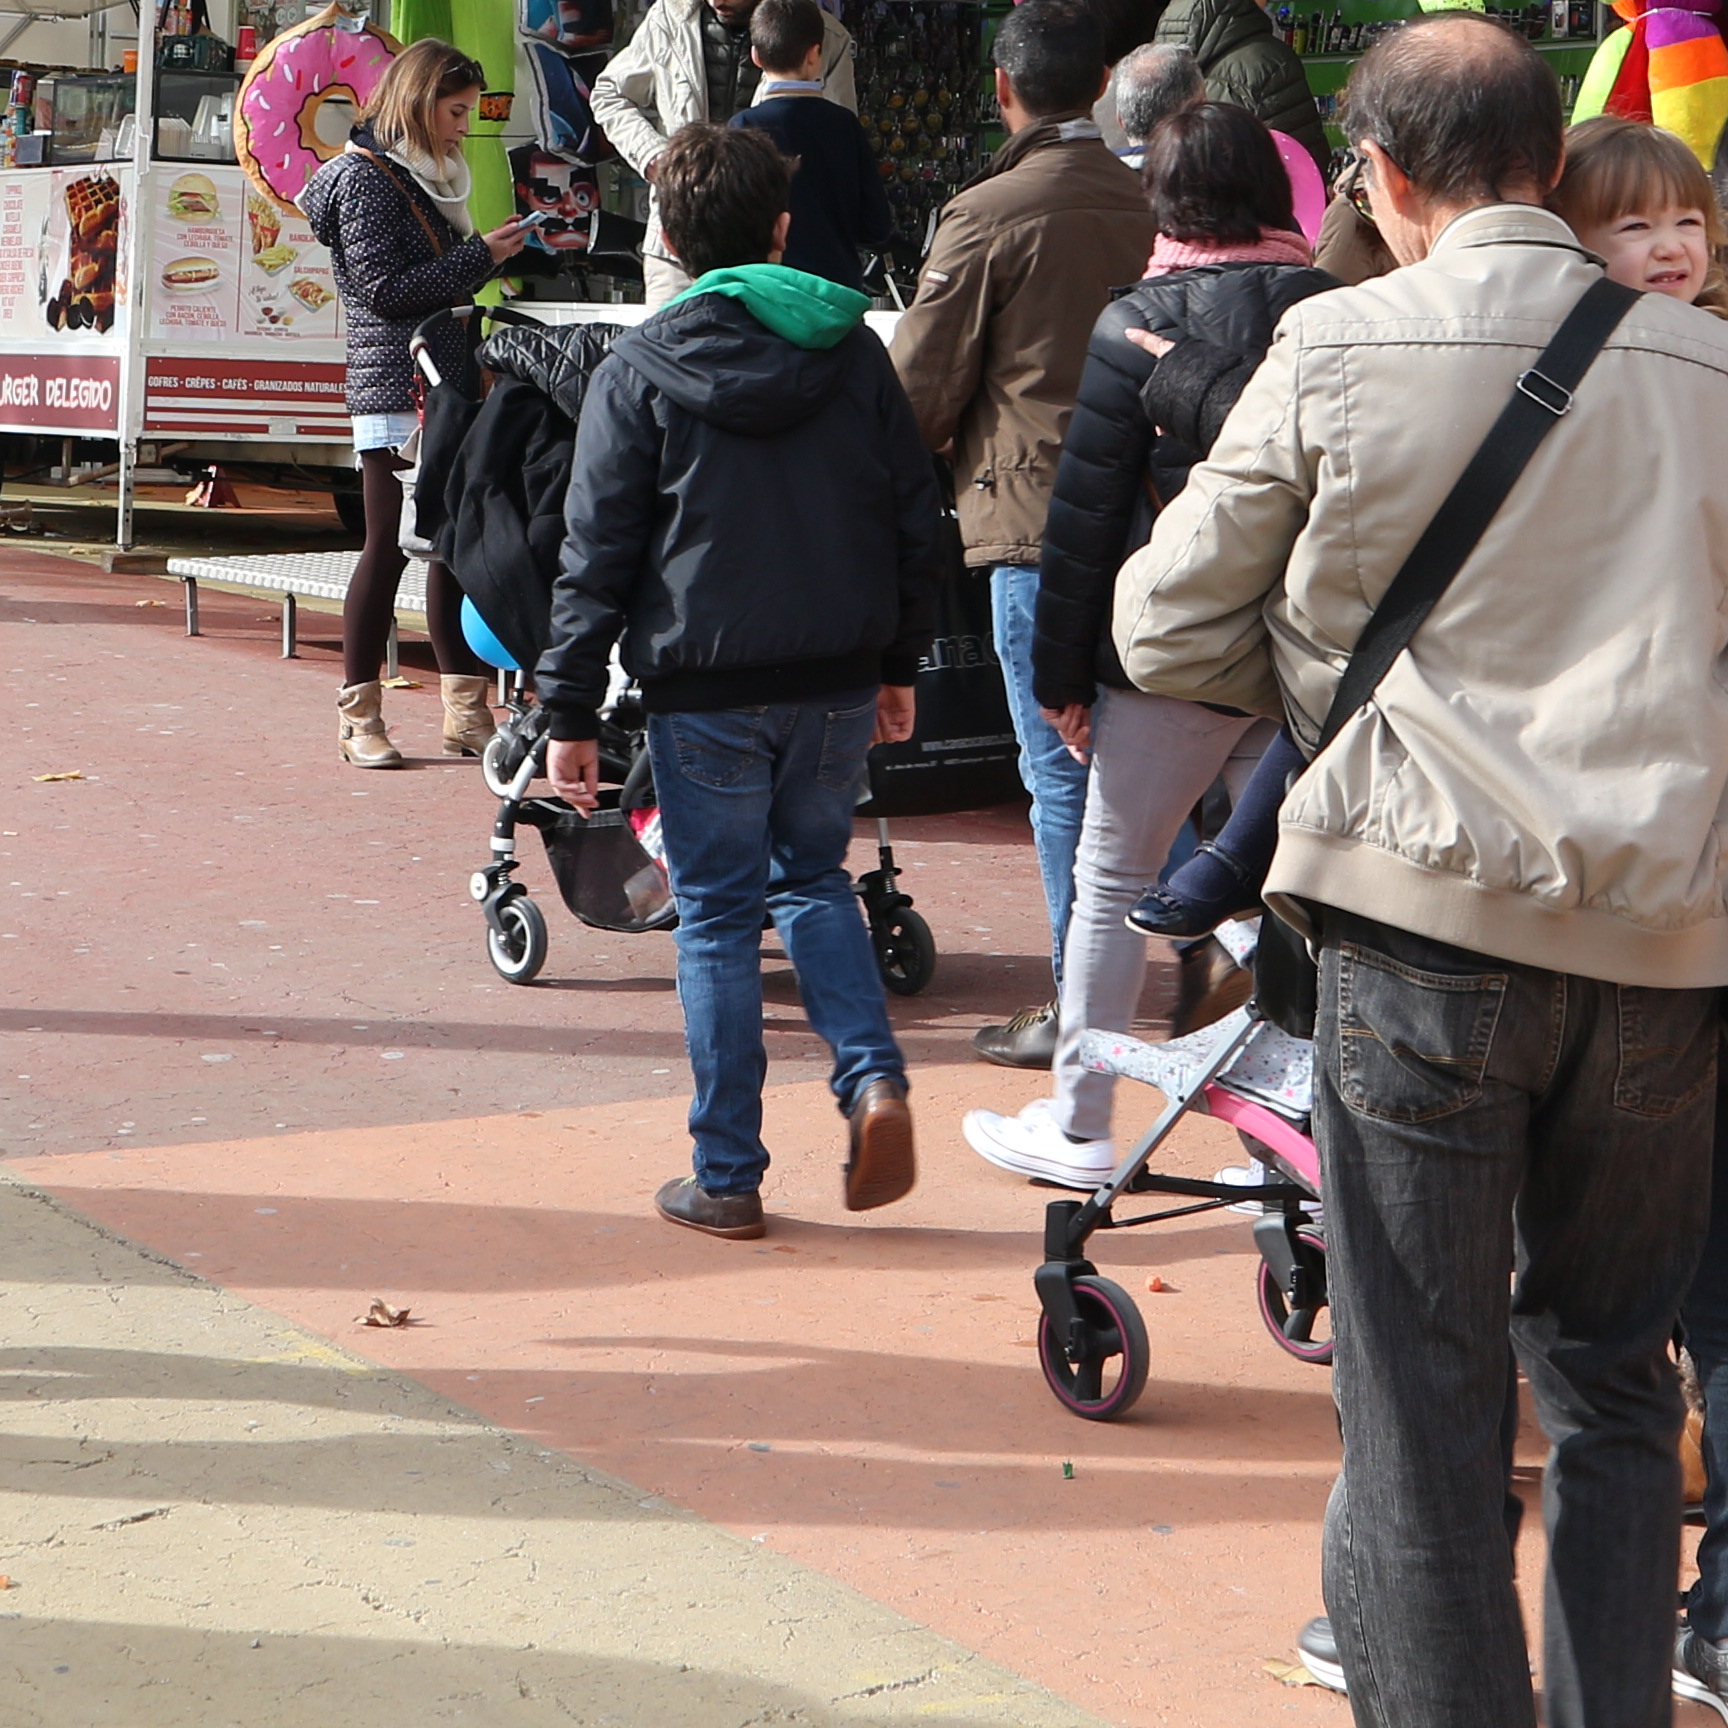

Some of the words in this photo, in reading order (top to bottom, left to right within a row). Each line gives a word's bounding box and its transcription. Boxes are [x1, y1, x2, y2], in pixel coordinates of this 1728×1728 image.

[45, 376, 113, 412] DELEGIDO
[148, 376, 179, 388] GOFRES
[185, 375, 216, 390] CRÊPES
[222, 376, 248, 390] CAFÉS
[254, 379, 303, 392] GRANIZADOS
[304, 381, 349, 394] NATURALES
